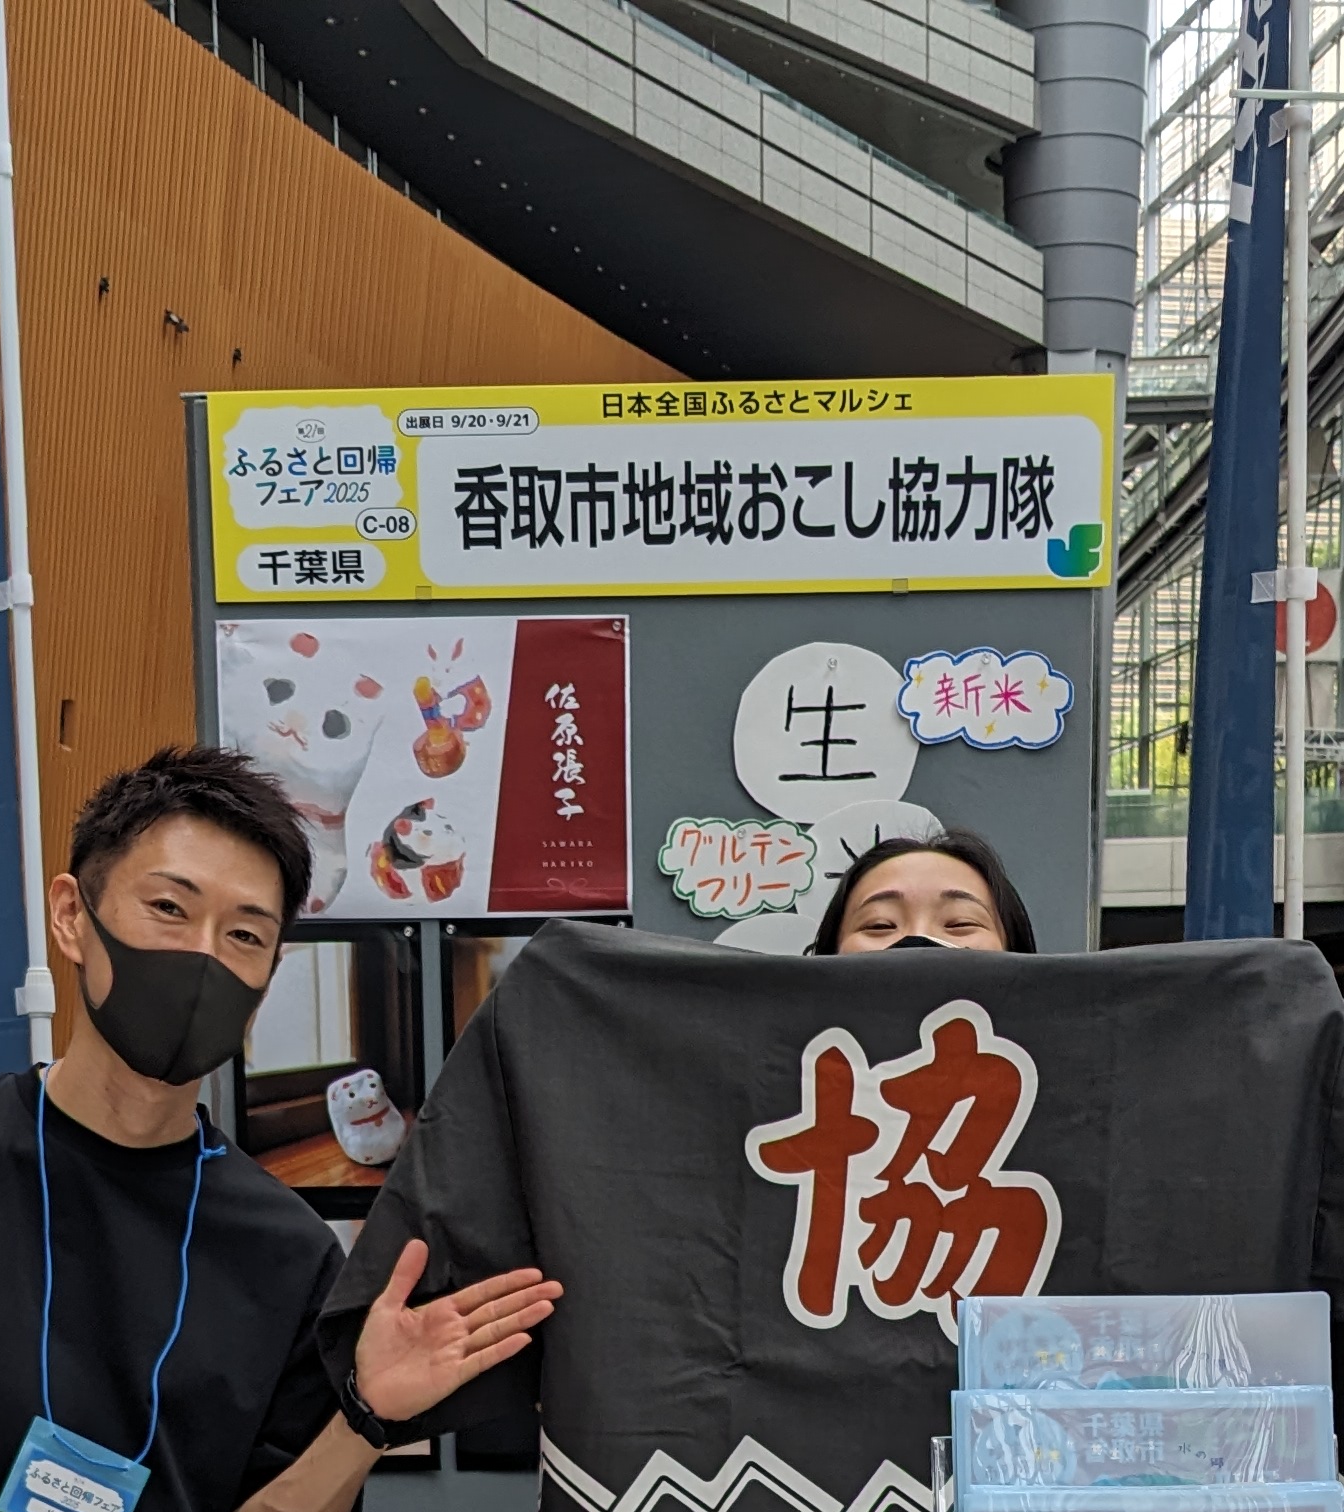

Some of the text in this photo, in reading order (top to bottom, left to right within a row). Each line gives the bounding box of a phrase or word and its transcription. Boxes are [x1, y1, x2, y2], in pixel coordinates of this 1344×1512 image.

[601, 387, 913, 418] 日本全国ふるさとマルシェ
[406, 416, 444, 429] 出展日
[229, 445, 397, 476] ふるさと回帰
[256, 479, 371, 506] フェア2025
[454, 455, 1055, 550] 香取市地域おこし協力隊
[362, 515, 410, 534] C-08
[258, 549, 366, 586] 千葉県
[933, 672, 1031, 717] 新米
[544, 682, 586, 821] 佐原張子
[779, 686, 875, 781] 生
[679, 828, 806, 868] グルテン
[697, 872, 791, 907] フリー
[757, 1013, 1051, 1320] 協
